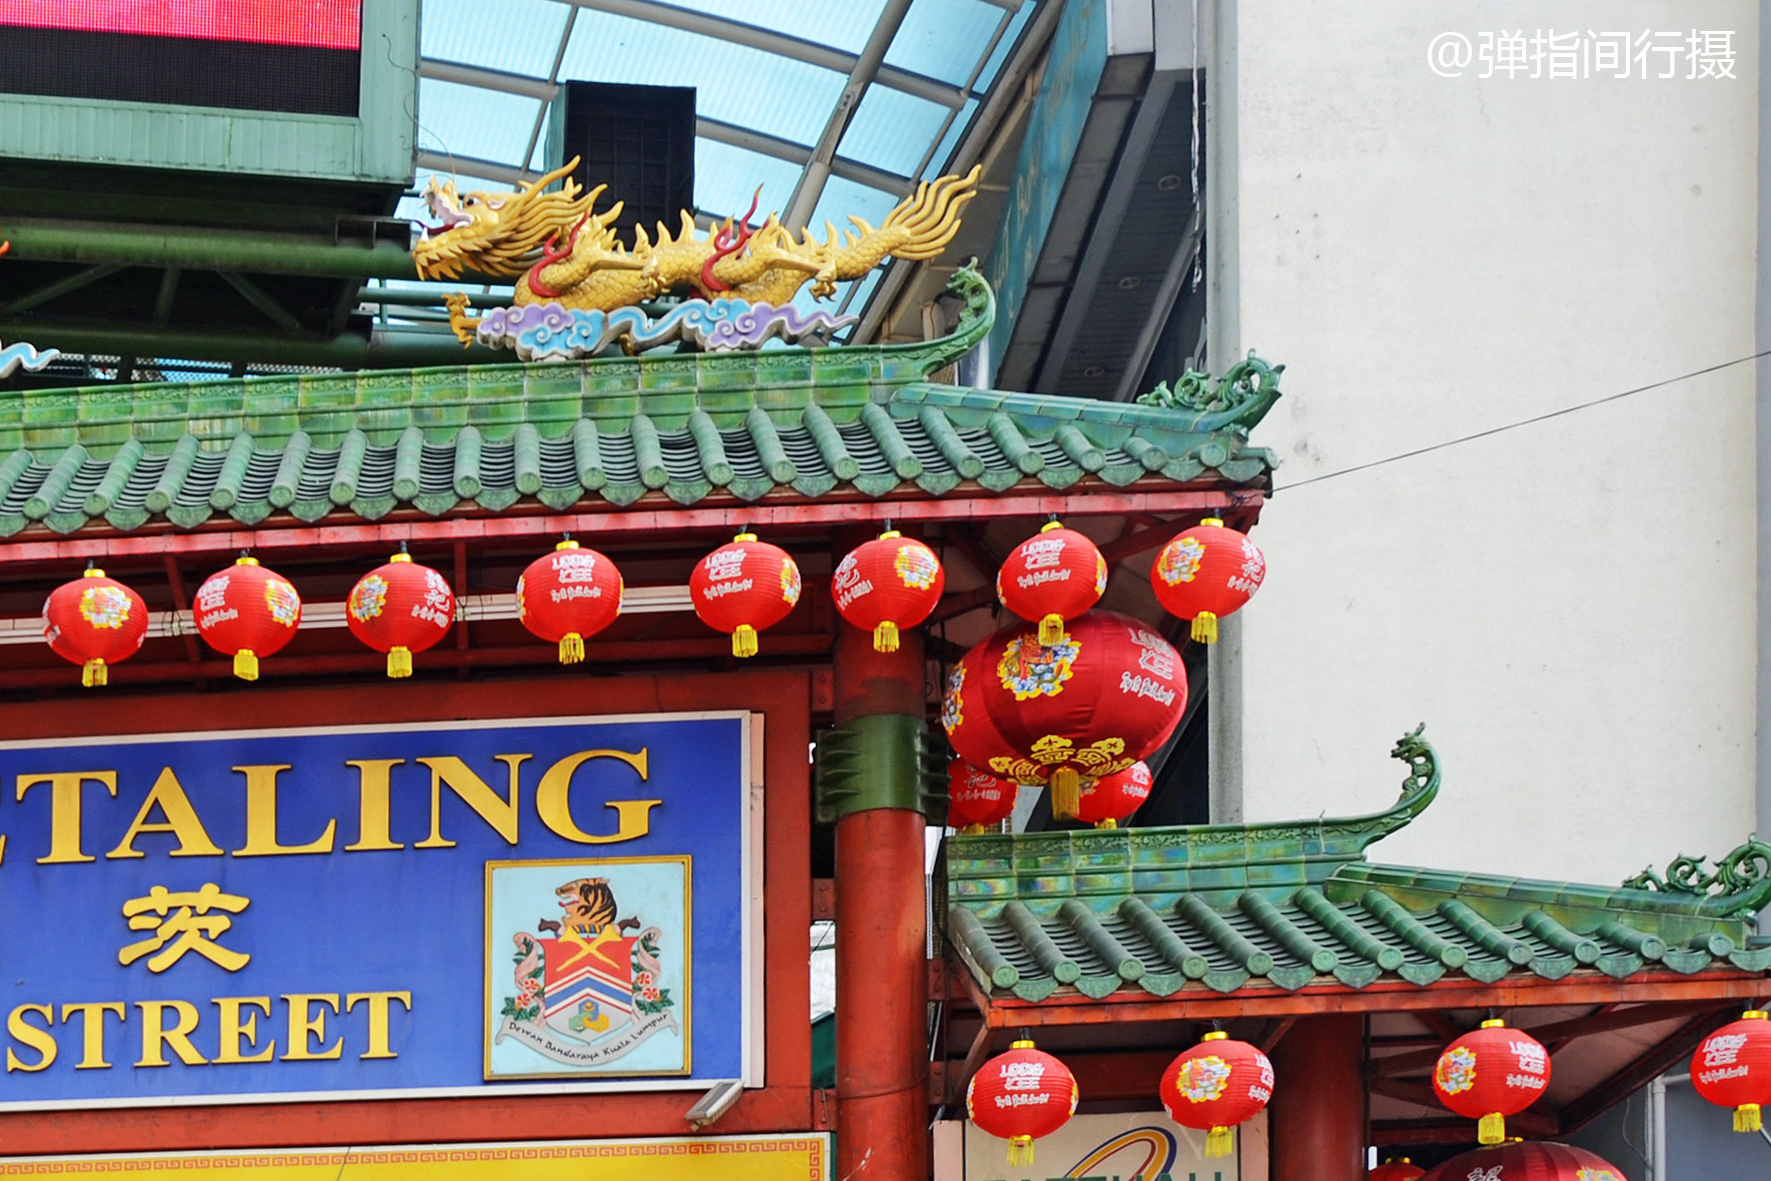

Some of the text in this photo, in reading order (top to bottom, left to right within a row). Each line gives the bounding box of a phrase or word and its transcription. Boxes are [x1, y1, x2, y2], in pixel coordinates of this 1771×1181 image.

[6, 990, 412, 1074] STREET
[508, 1021, 543, 1045] Dewan
[545, 1041, 600, 1062] Bandaraya
[603, 1039, 631, 1056] Kuala
